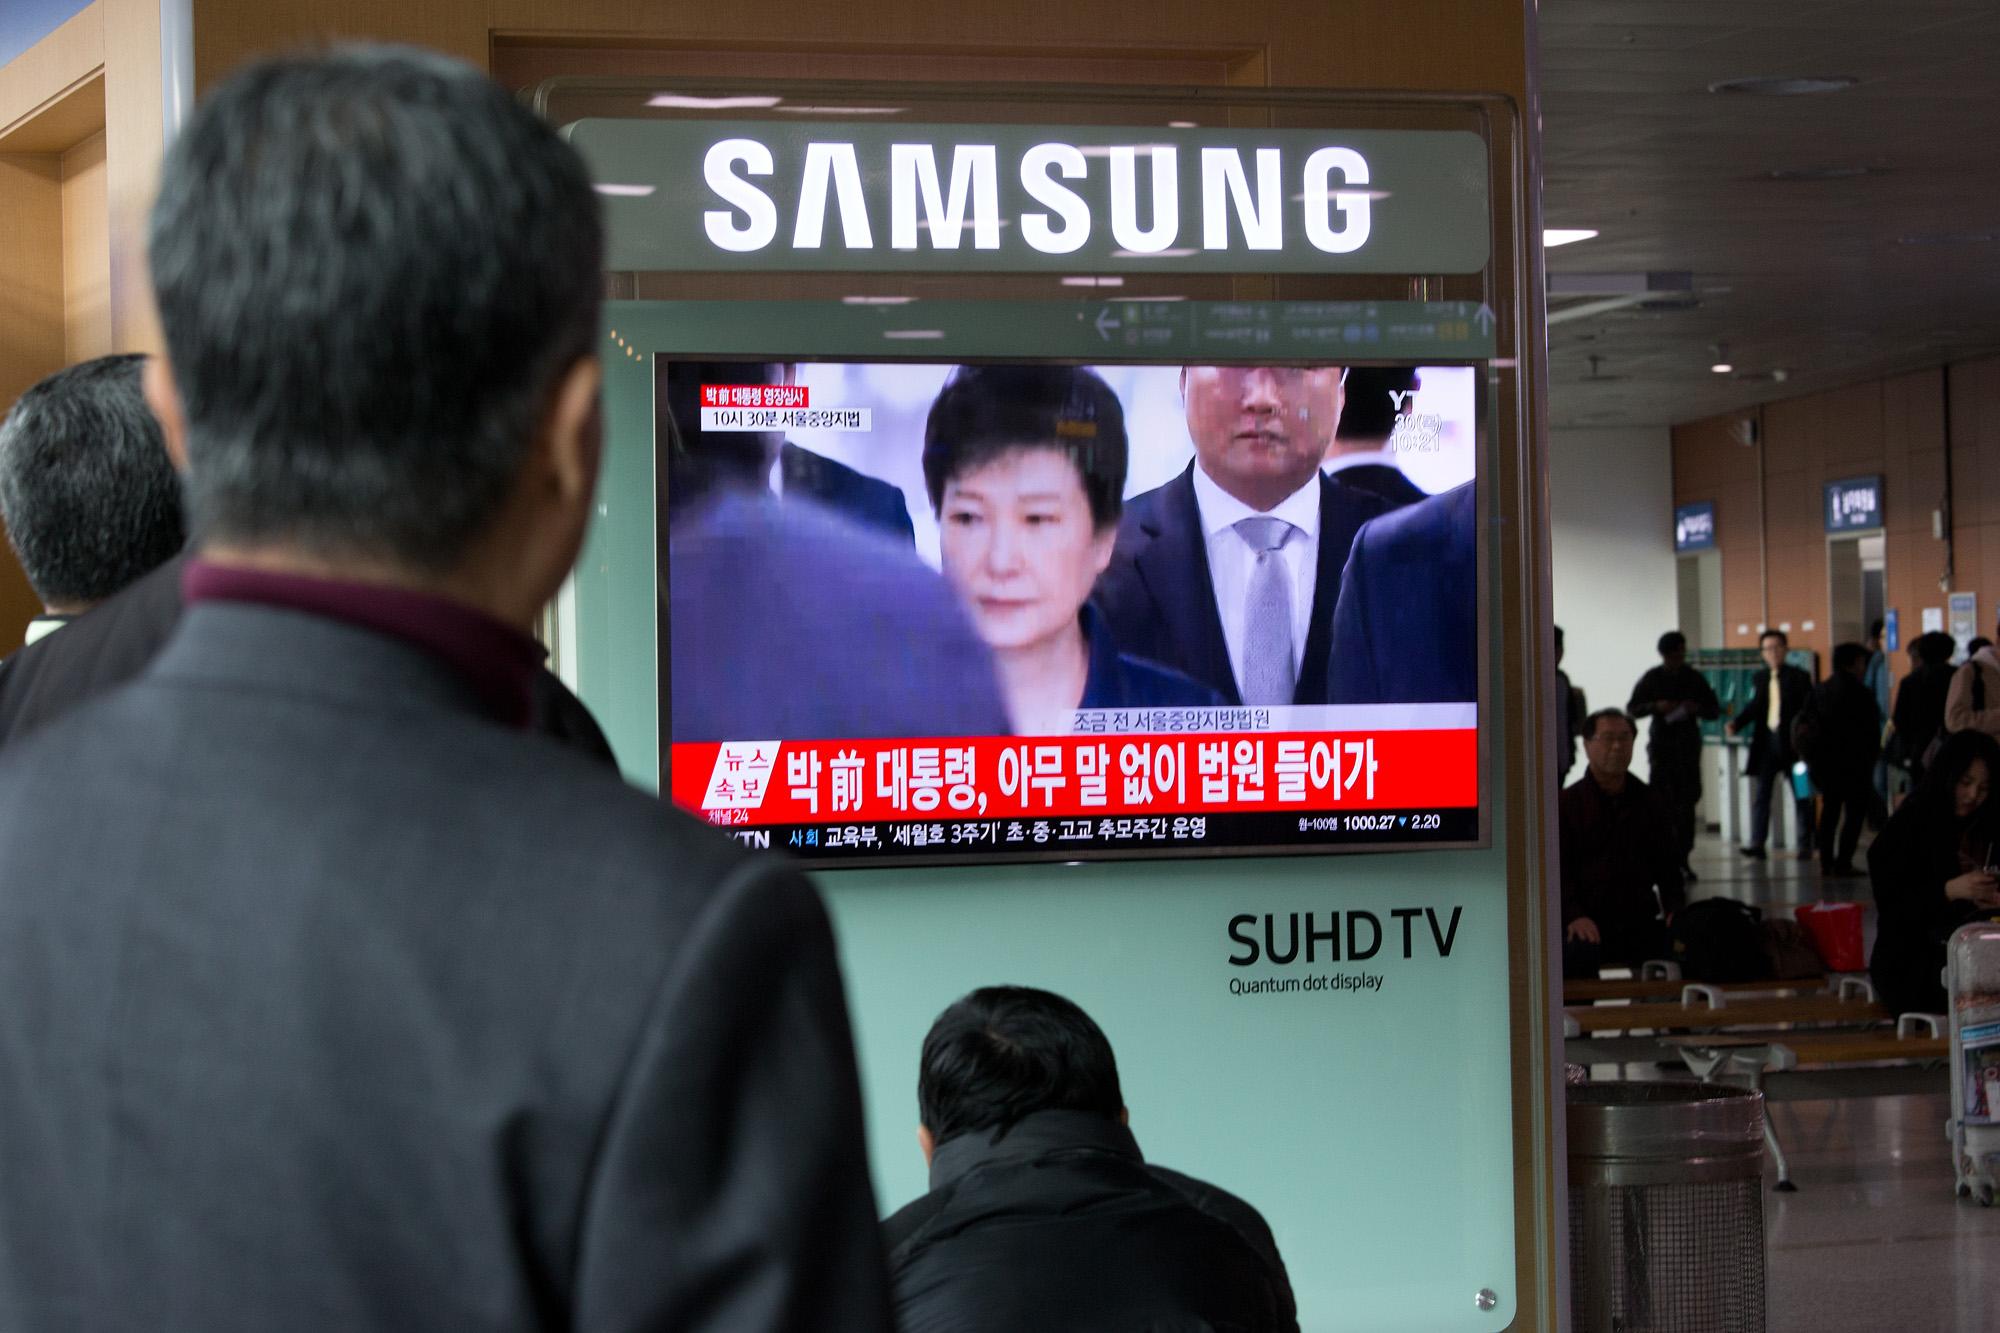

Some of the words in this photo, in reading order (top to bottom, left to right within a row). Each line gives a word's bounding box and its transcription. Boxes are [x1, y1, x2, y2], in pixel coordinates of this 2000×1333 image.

[703, 138, 1371, 254] SAMSUNG
[706, 386, 717, 405] 박
[718, 387, 729, 405] 前
[731, 387, 761, 406] 대통령
[763, 387, 804, 406] 영장심사
[713, 410, 743, 427] 10시
[747, 410, 777, 427] 30분
[781, 410, 860, 427] 서울중앙지법
[1074, 711, 1107, 733] 조금
[1113, 711, 1129, 732] 전
[1134, 709, 1270, 732] 서울중앙지방법원
[723, 748, 769, 773] 뉴스
[787, 749, 822, 813] 박
[830, 749, 865, 812] 前
[876, 746, 987, 815] 대통령,
[998, 744, 1066, 807] 아무
[1076, 742, 1110, 806] 말
[1119, 740, 1186, 806] 없이
[1199, 739, 1265, 804] 법원
[1274, 737, 1378, 801] 들어가
[715, 777, 762, 802] 속보
[789, 828, 819, 847] 사회
[825, 825, 882, 849] 교육부,
[951, 821, 1000, 844] 3주기'
[1098, 818, 1168, 841] 추모주간
[1172, 816, 1206, 839] 운영
[1343, 814, 1396, 831] 1000.27
[1411, 814, 1441, 830] 2.20
[1228, 909, 1383, 966] SUHD
[1391, 906, 1463, 959] TV
[1229, 976, 1300, 996] Quantum
[1303, 973, 1328, 992] dot
[1331, 971, 1384, 993] display
